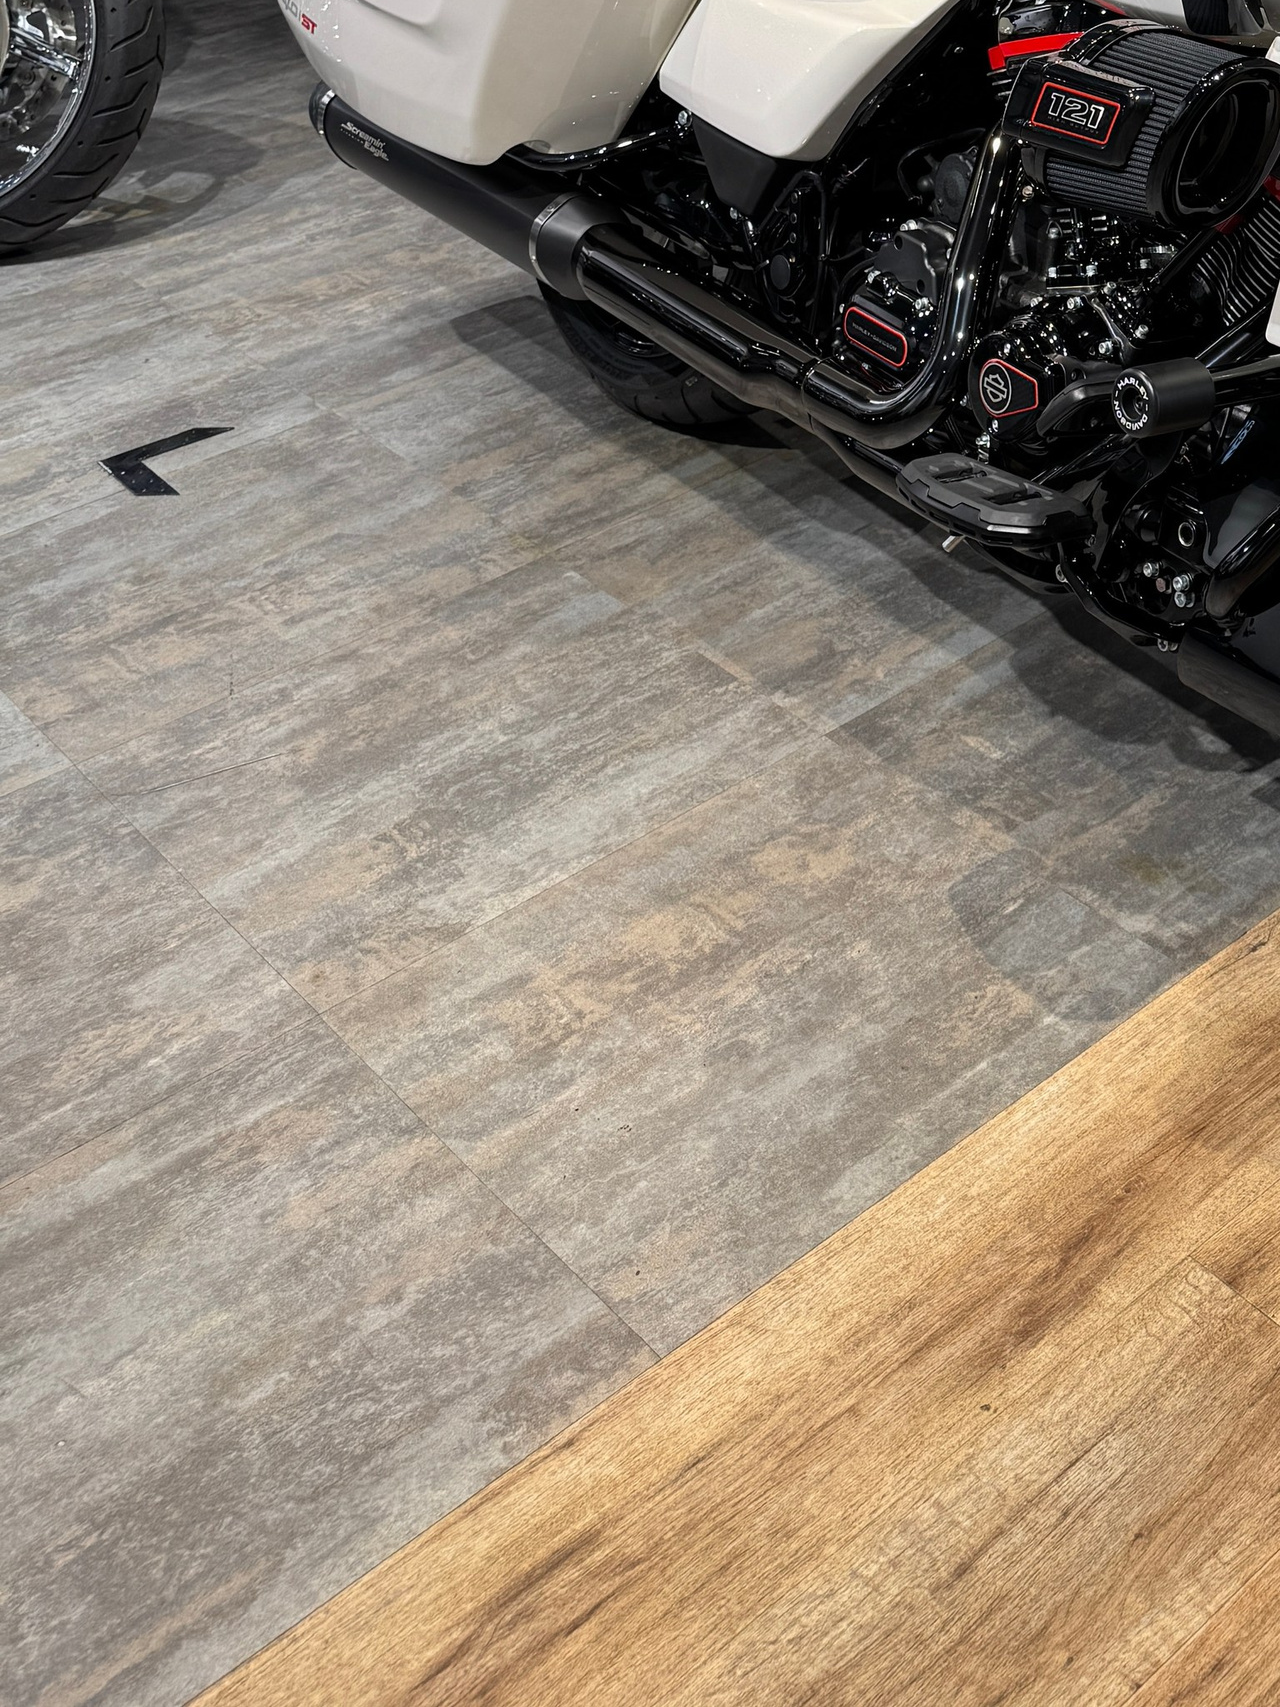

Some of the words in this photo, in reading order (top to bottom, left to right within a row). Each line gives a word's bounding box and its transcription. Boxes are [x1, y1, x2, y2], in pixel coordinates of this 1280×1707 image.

[301, 13, 318, 34] ST
[1048, 92, 1105, 129] 121
[364, 140, 390, 162] Eagle
[1116, 376, 1149, 401] HARLEY
